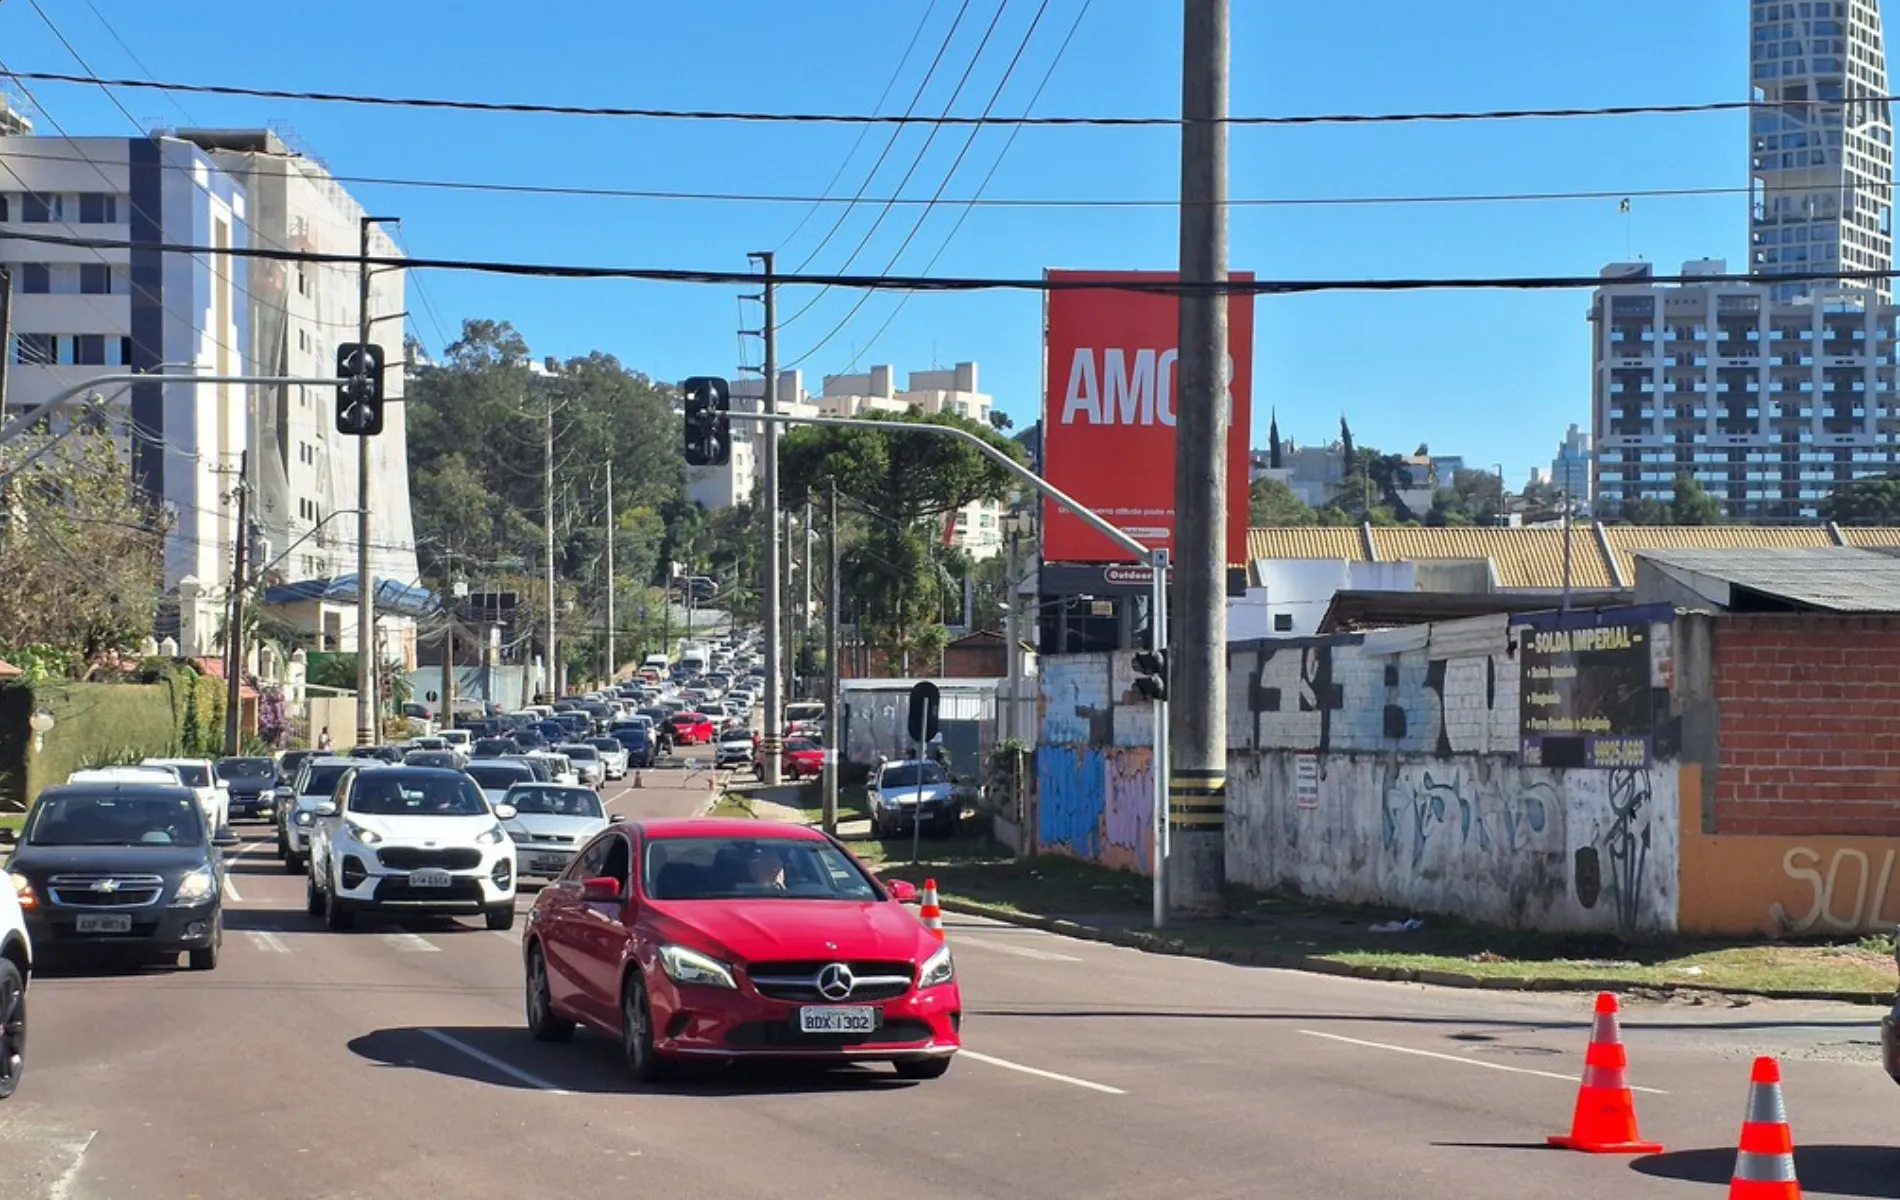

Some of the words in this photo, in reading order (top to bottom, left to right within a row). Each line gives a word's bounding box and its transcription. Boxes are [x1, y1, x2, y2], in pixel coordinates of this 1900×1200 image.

[1109, 570, 1153, 580] Outdoor
[1535, 631, 1570, 654] SOLDA
[1573, 626, 1631, 651] IMPERIAL
